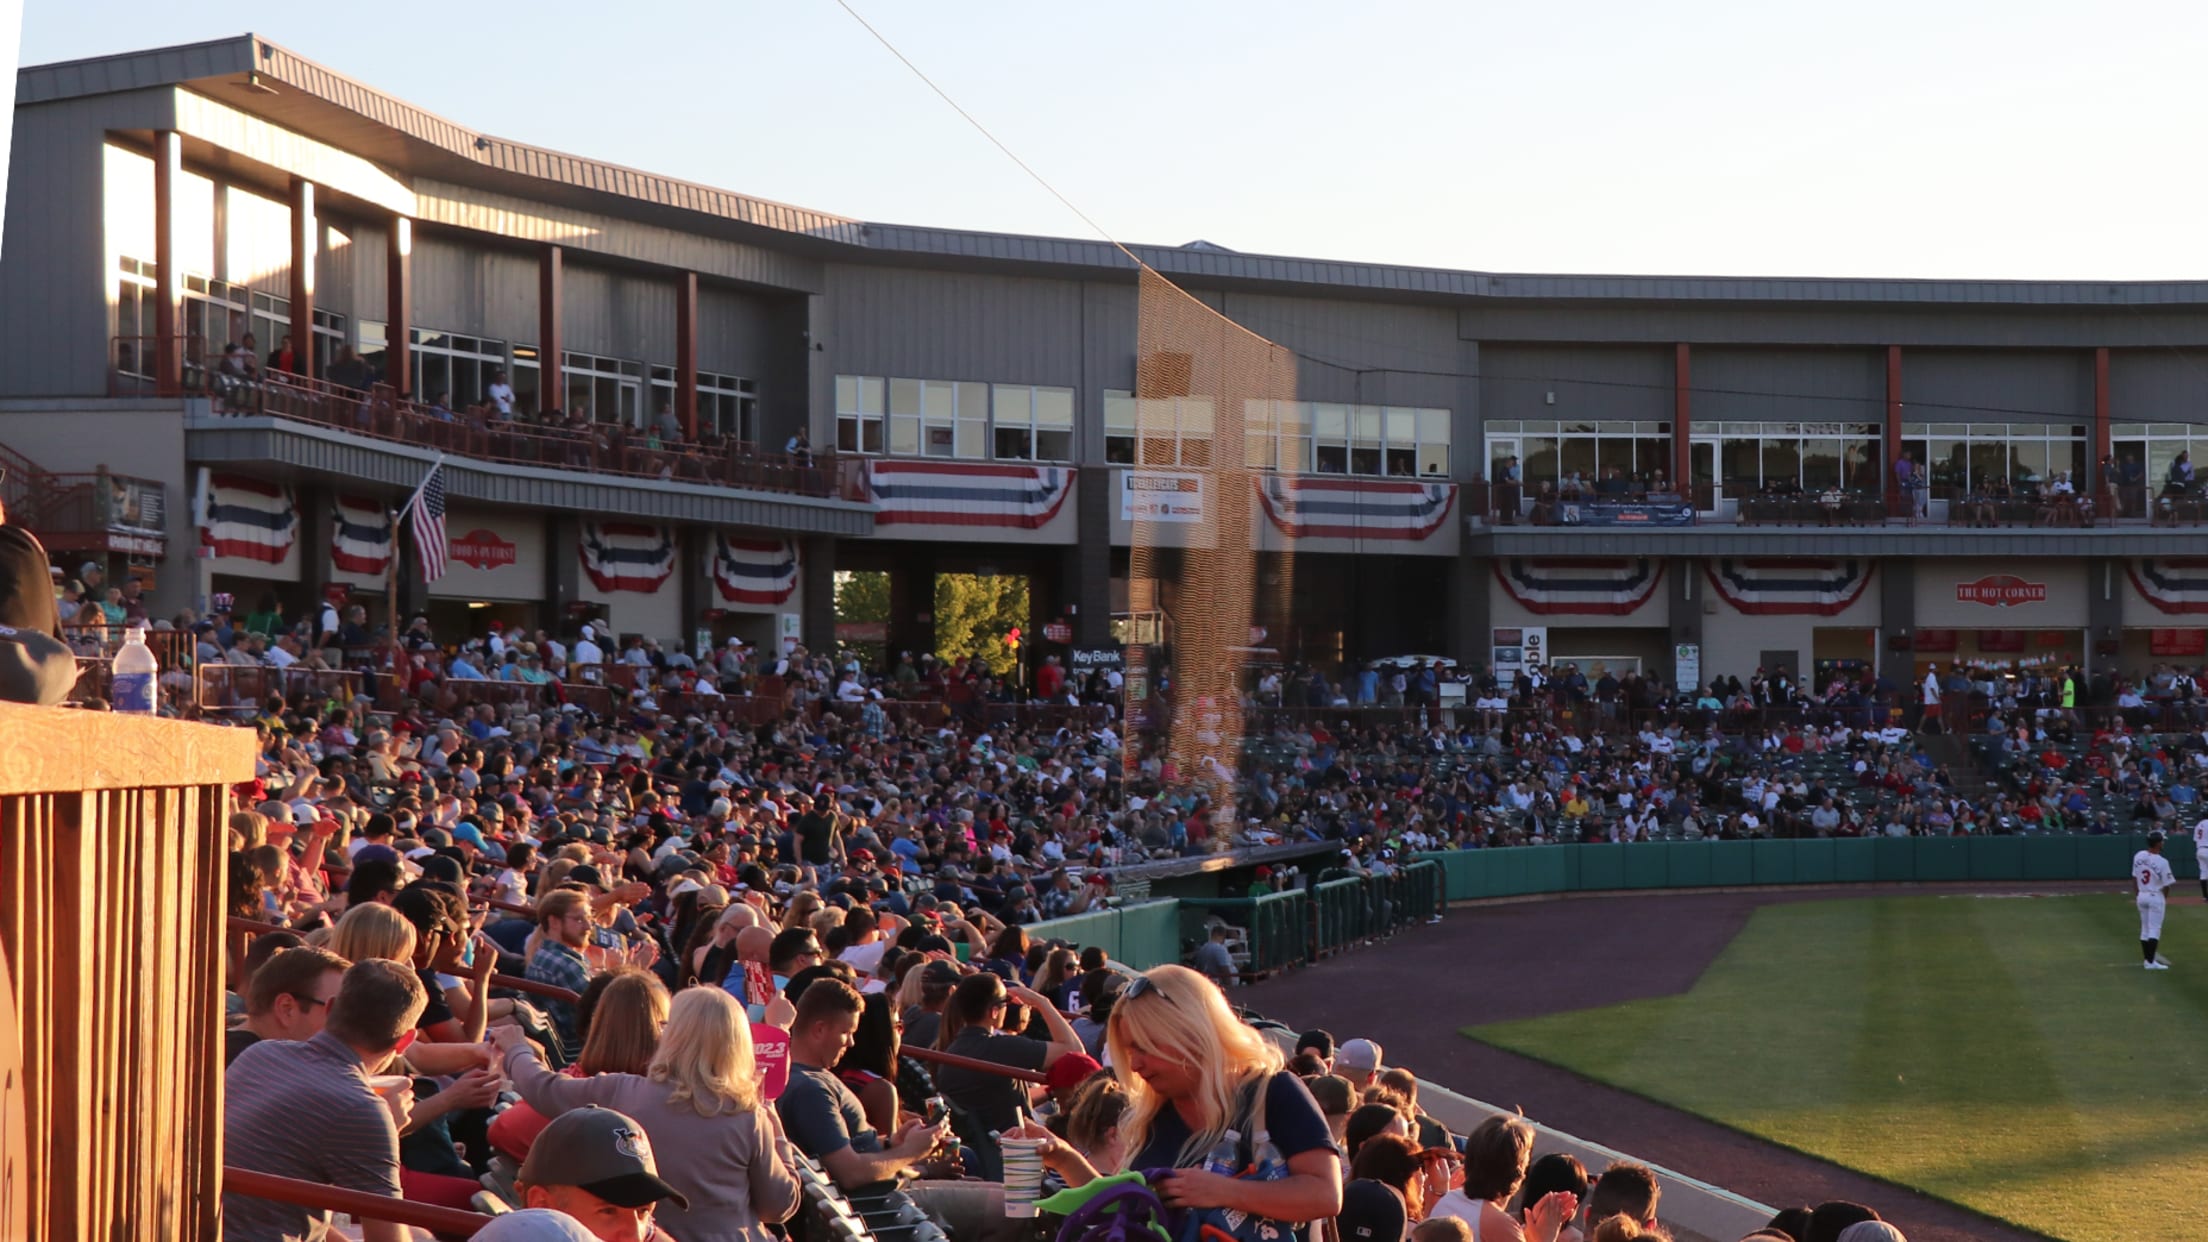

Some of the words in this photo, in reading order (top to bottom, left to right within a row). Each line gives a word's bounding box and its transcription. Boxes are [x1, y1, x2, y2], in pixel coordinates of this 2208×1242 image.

[1959, 587, 1977, 598] THE
[1981, 587, 2002, 598] HOT
[2005, 587, 2045, 598] CORNER
[1073, 649, 1121, 664] KeyBank
[2141, 869, 2151, 885] 3
[1068, 990, 1080, 1014] 6
[754, 1041, 786, 1055] 02.3
